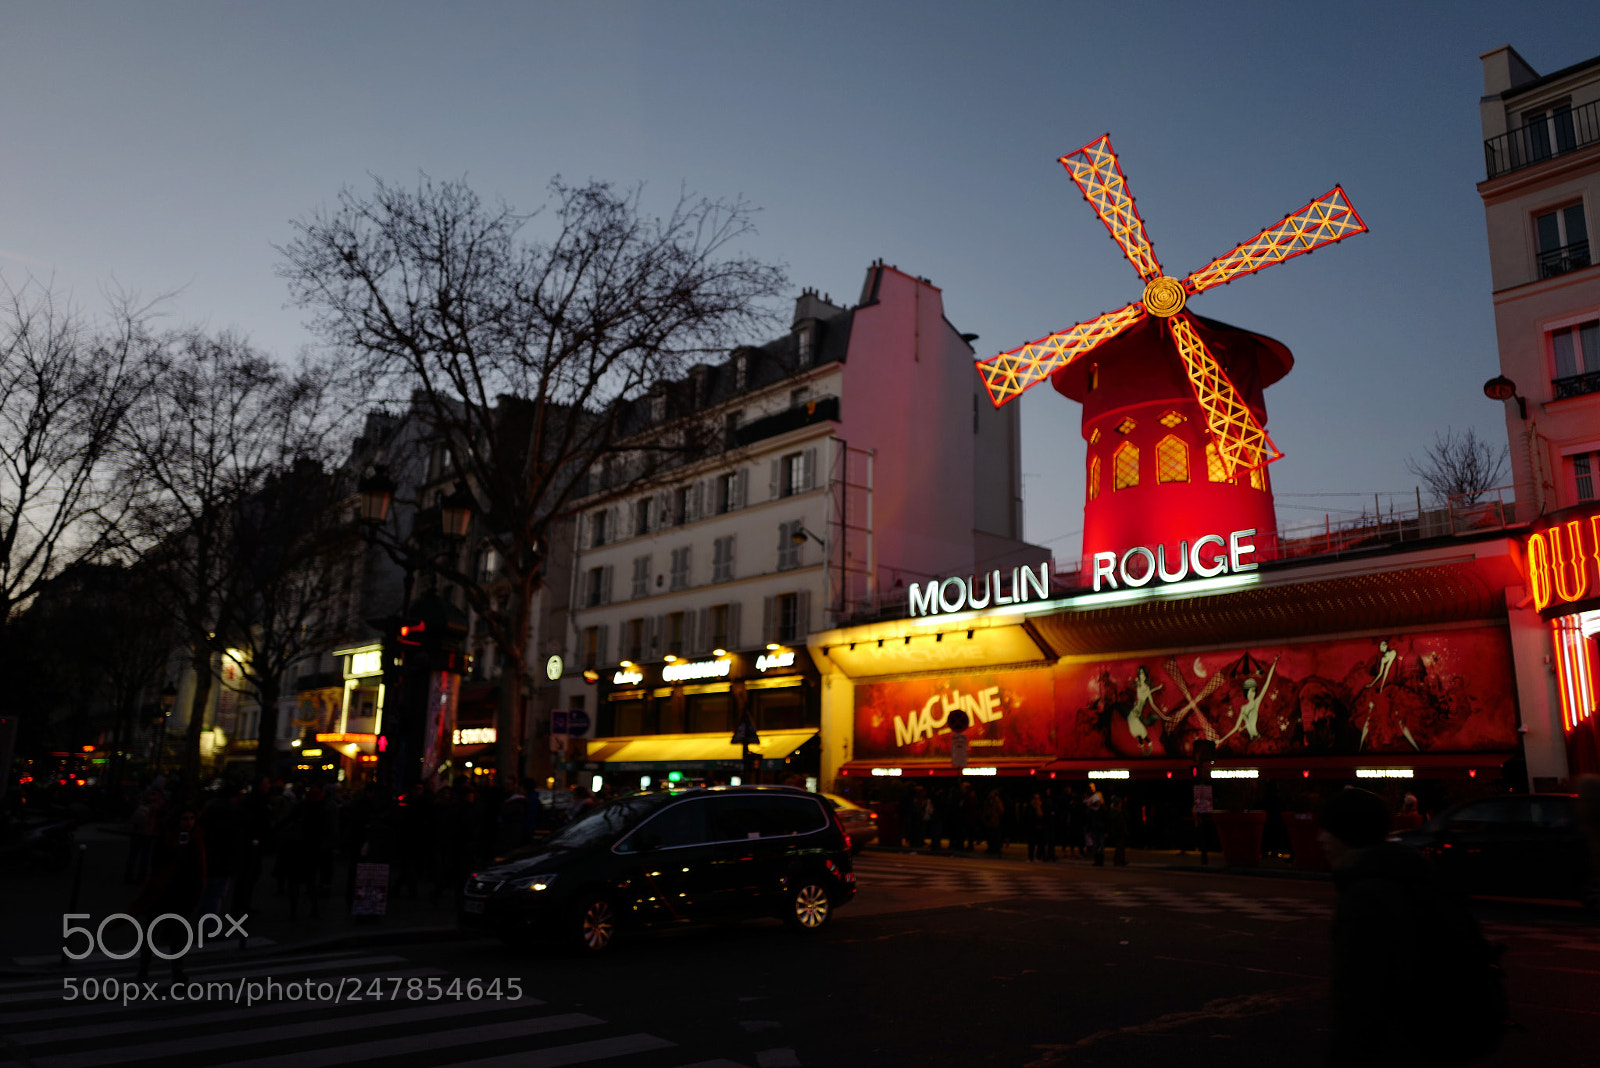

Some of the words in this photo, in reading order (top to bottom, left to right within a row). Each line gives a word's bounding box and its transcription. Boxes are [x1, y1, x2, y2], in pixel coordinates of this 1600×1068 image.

[908, 562, 1050, 617] MOULIN
[1092, 528, 1259, 592] ROUGE
[893, 685, 1004, 747] MACHINE
